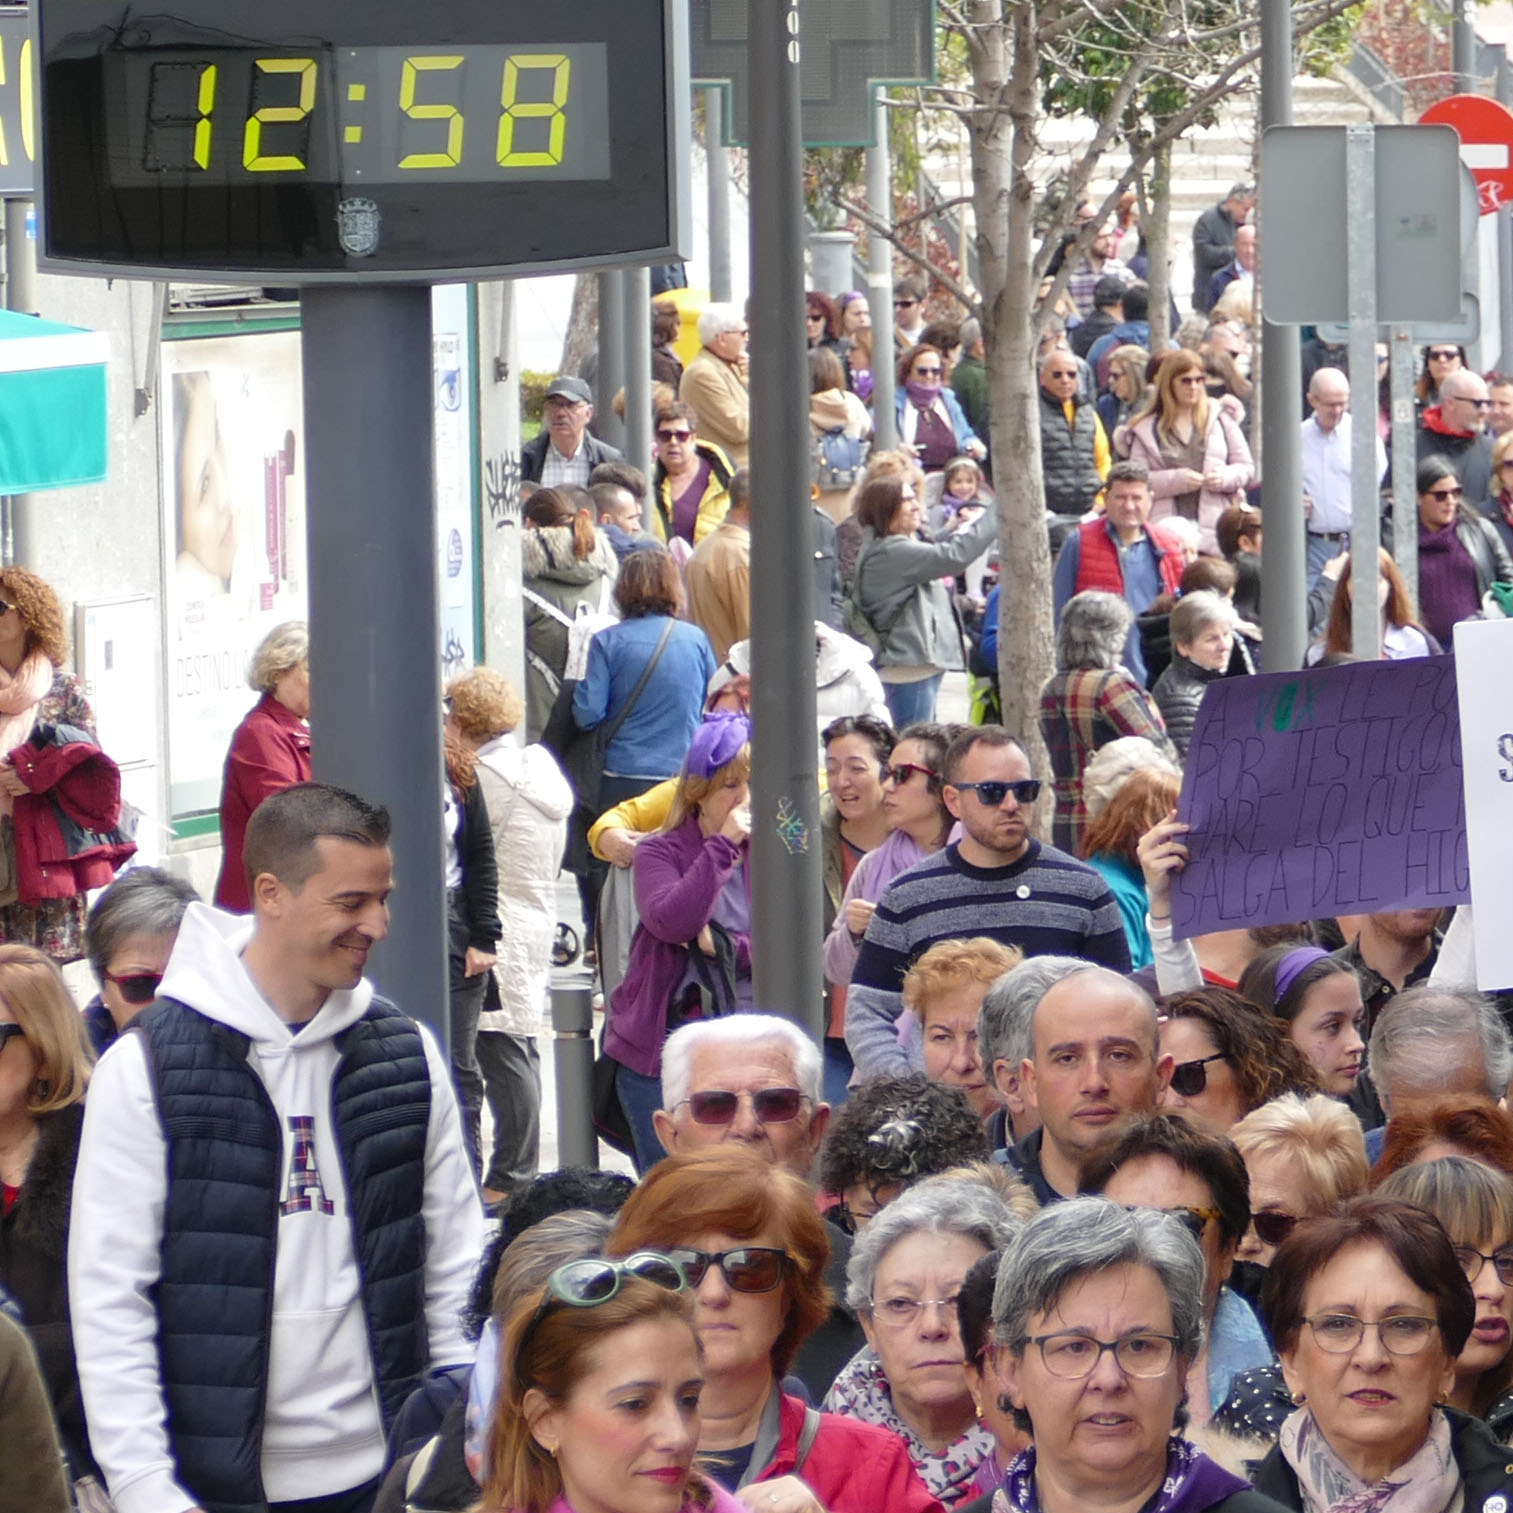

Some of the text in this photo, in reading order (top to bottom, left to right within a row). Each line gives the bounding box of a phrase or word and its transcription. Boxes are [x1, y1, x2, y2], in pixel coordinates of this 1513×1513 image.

[193, 54, 571, 172] 12:58
[1203, 687, 1230, 739] A
[1338, 669, 1399, 723] LE
[1191, 738, 1261, 806] POR
[1292, 711, 1449, 789] TESTIGO
[1294, 783, 1348, 848] LO
[1364, 771, 1438, 839] QUE
[1180, 829, 1470, 927] SALGA DEL HIG
[280, 1115, 335, 1216] A
